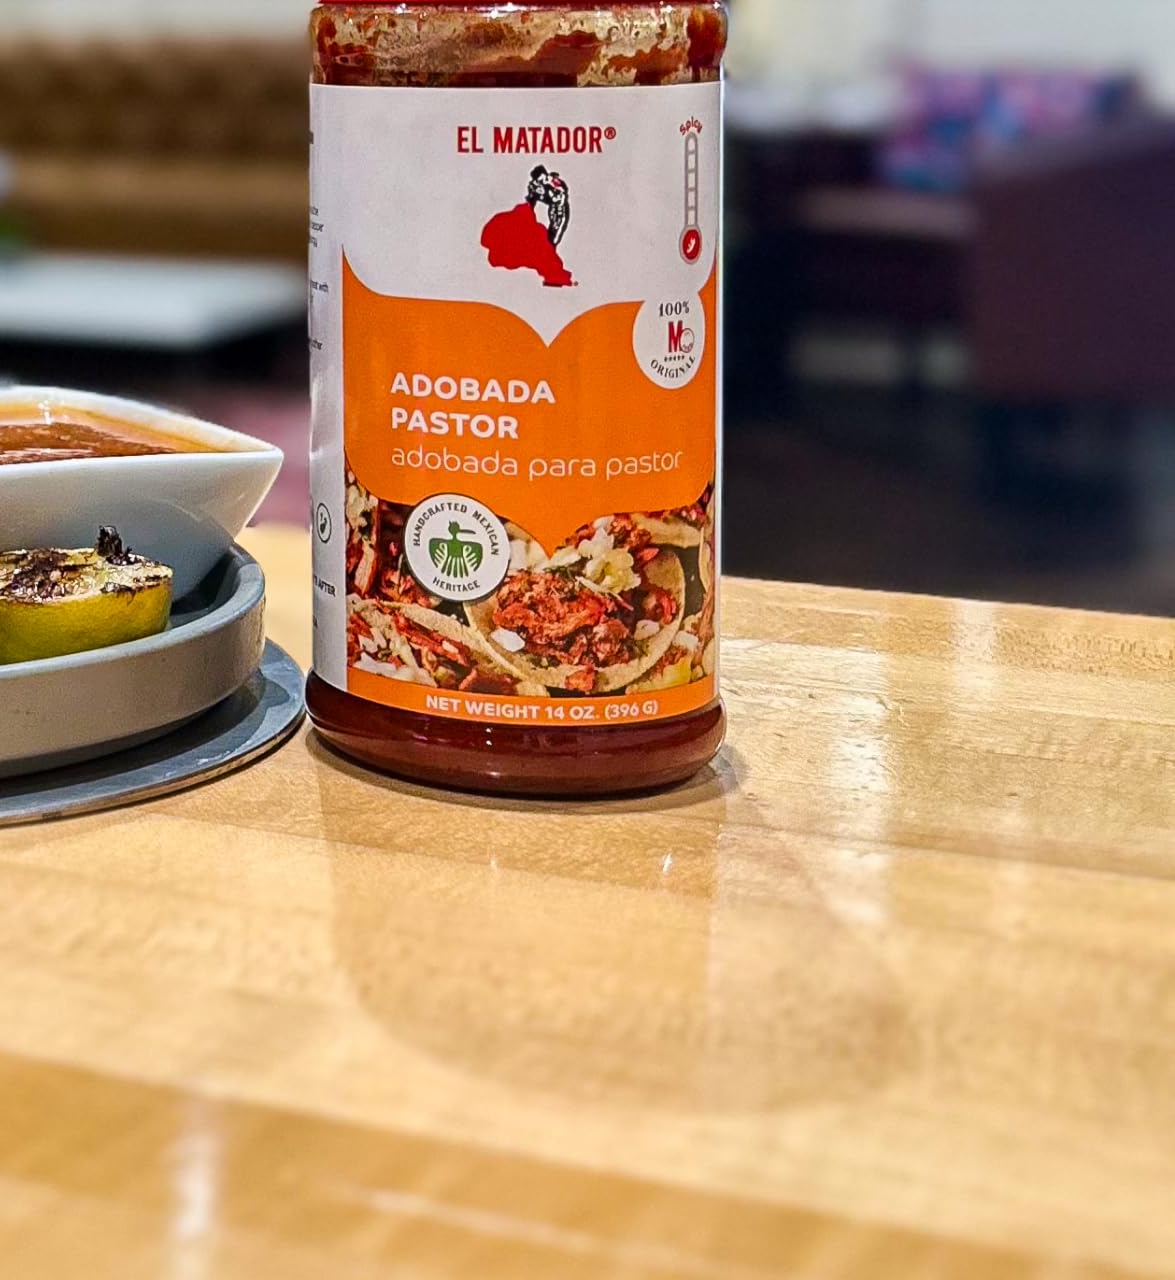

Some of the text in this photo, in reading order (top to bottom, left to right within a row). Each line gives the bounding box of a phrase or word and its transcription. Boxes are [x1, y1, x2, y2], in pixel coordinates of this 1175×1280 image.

[457, 126, 484, 153] EL
[659, 301, 690, 317] 100%
[651, 356, 695, 378] ORIGINAL
[391, 372, 556, 404] ADOBADA
[391, 407, 519, 439] PASTOR
[391, 445, 683, 481] adobada para pastor
[413, 503, 499, 556] HANDCRAFTED MEXICAN
[432, 577, 480, 592] HERITAGE
[426, 695, 658, 720] NET WEIGHT 14 OZ. (396 G)
